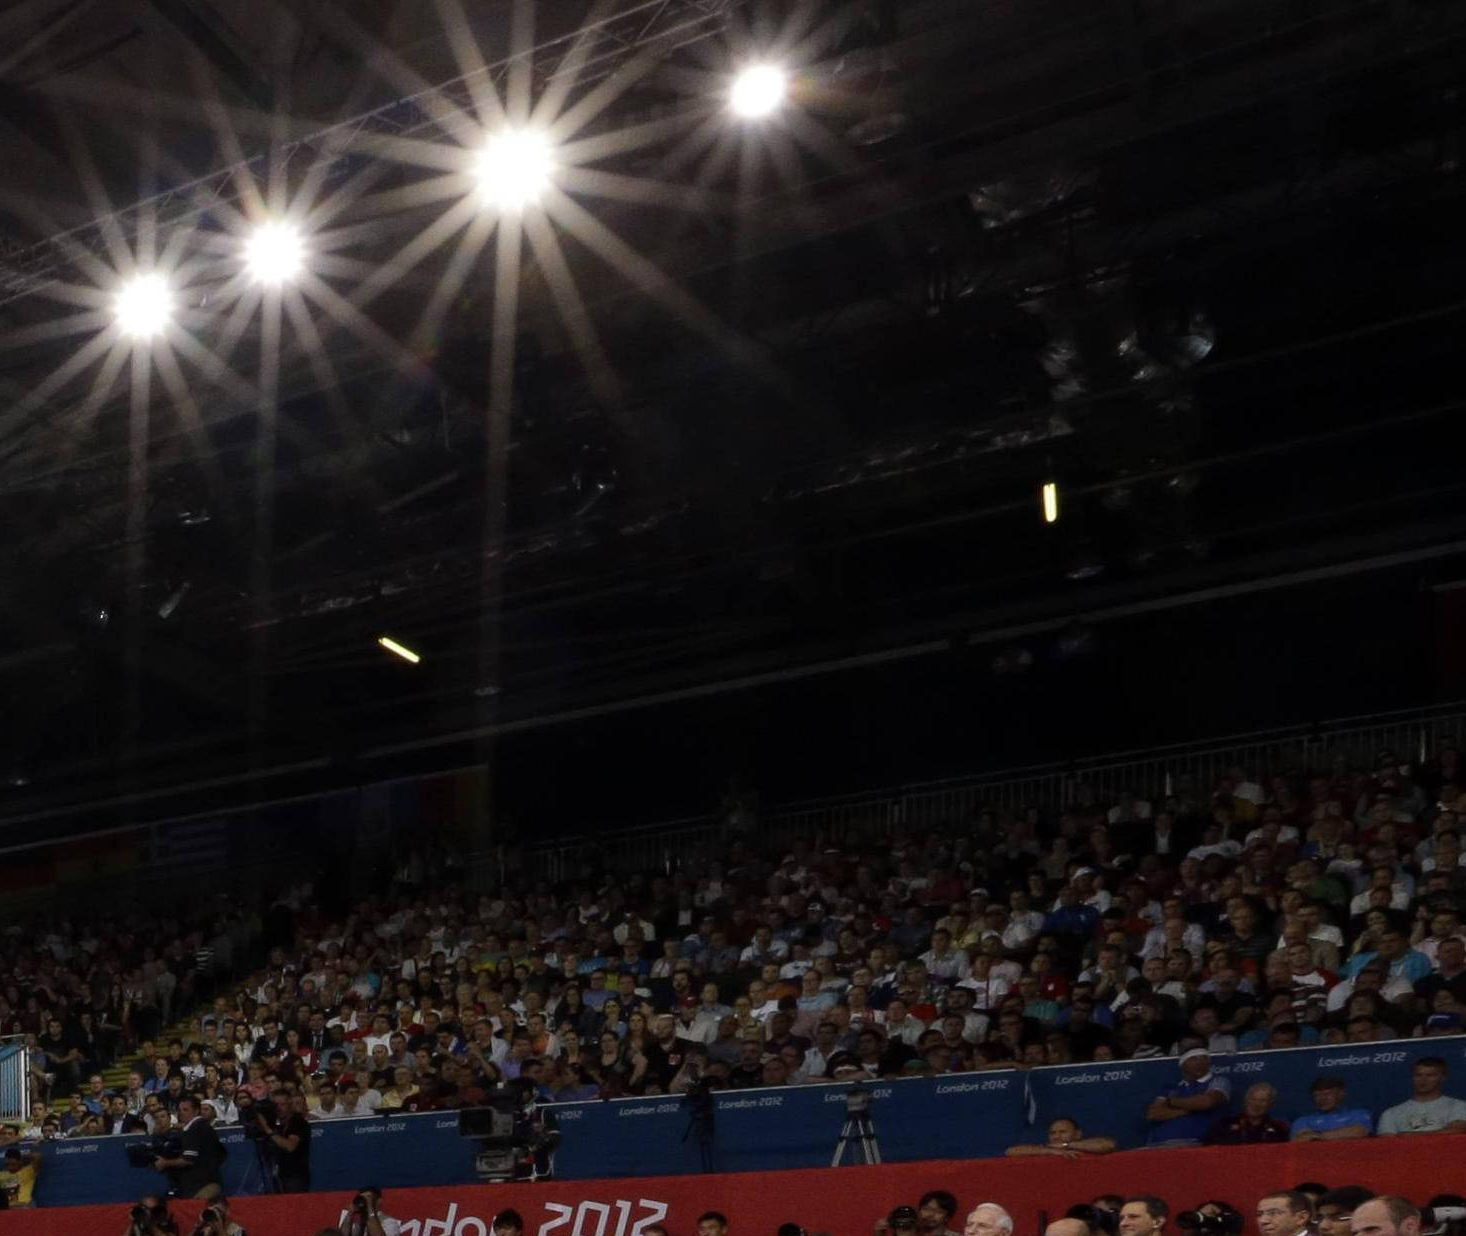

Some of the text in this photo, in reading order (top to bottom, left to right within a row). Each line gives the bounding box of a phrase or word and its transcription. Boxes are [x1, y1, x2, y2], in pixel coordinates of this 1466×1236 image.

[1318, 1051, 1406, 1067] London 2012
[1233, 1061, 1265, 1072] 2012
[1054, 1070, 1132, 1085] London 2012
[936, 1080, 1009, 1094] London 2012
[719, 1097, 783, 1110] London 2012
[619, 1104, 680, 1117] London 2012
[354, 1122, 406, 1135] London 2012
